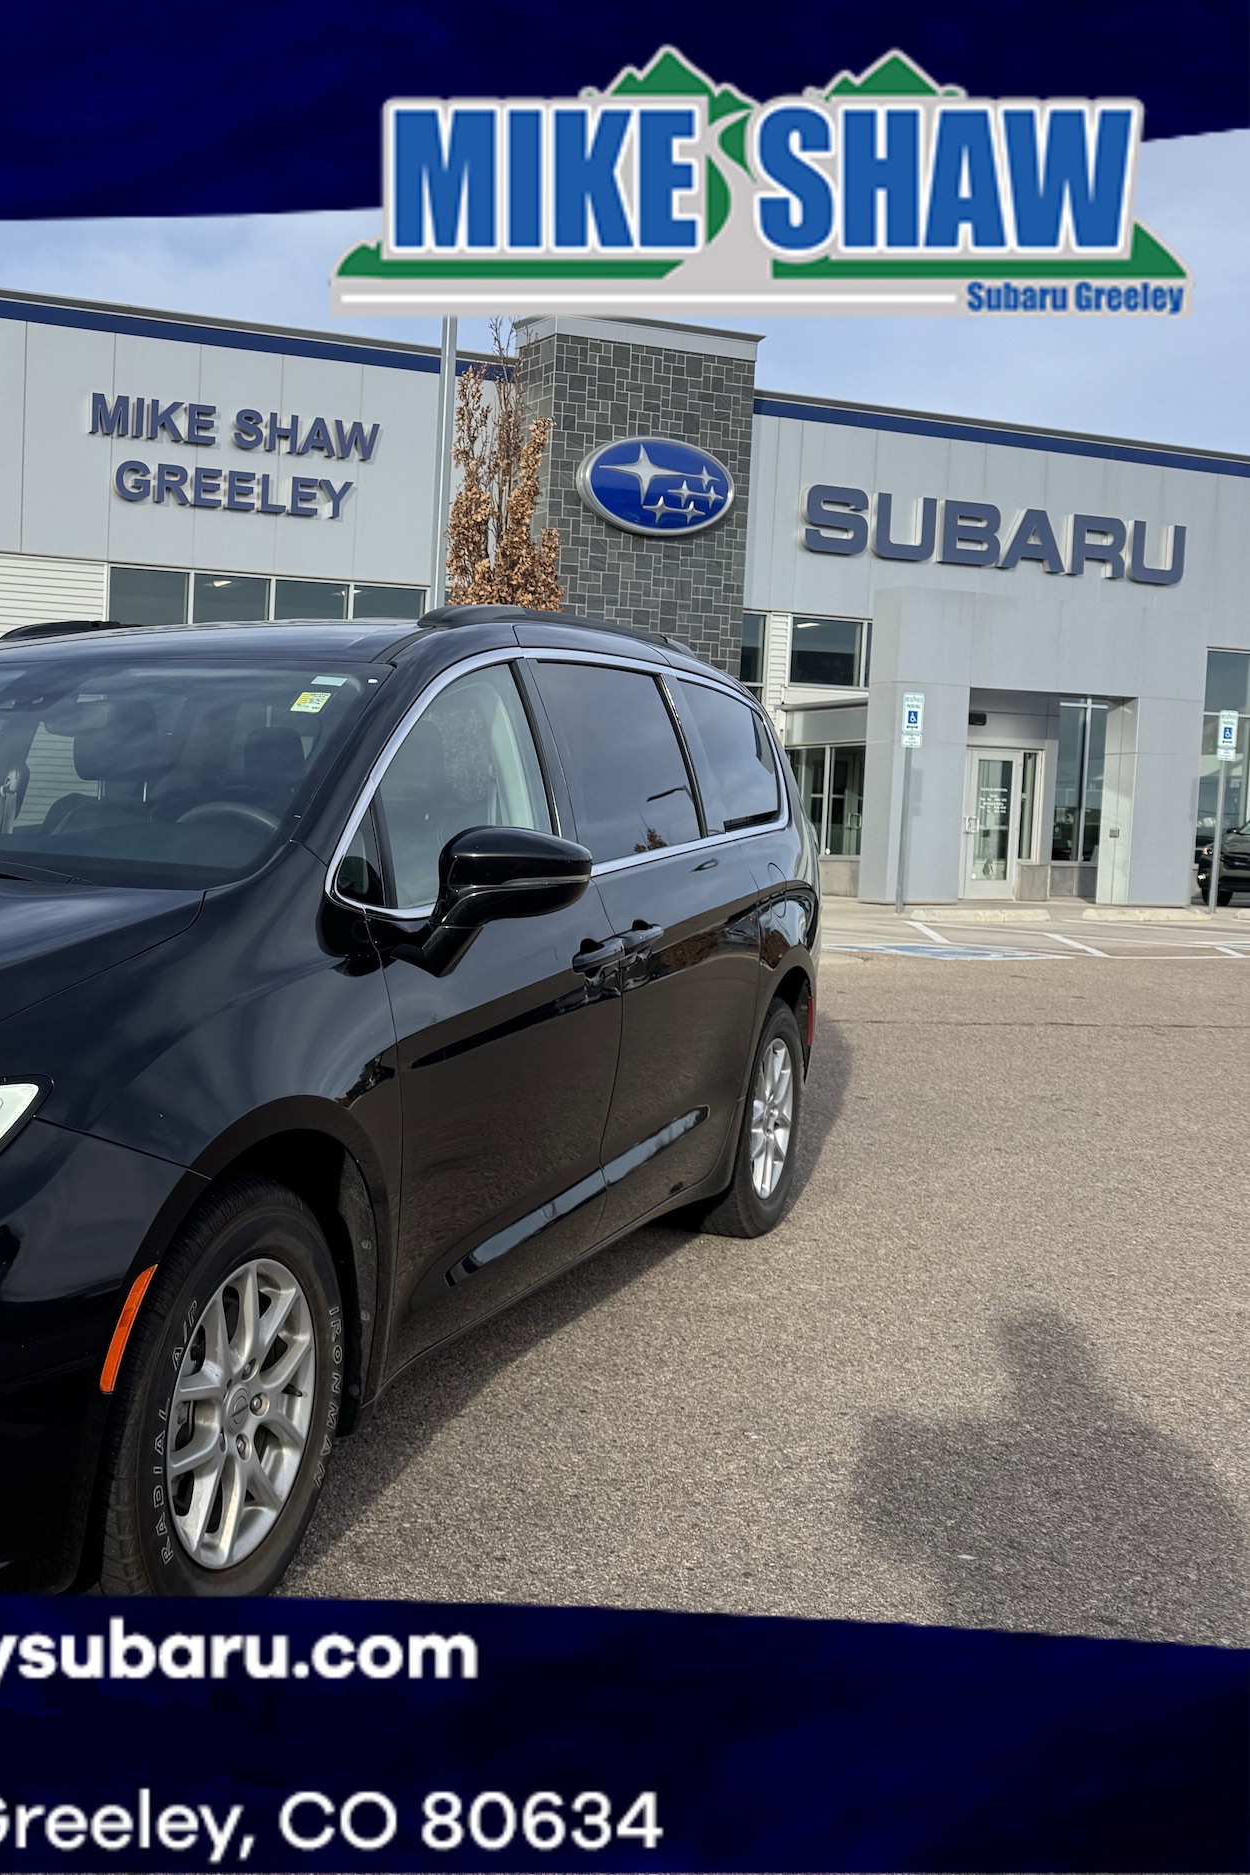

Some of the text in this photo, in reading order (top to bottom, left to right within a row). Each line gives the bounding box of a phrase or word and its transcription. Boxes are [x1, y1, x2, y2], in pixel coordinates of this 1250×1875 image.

[90, 392, 381, 462] MIKE SHAW
[114, 460, 355, 519] GREELEY
[800, 483, 1188, 586] SUBARU
[313, 1306, 343, 1488] IRONMAN
